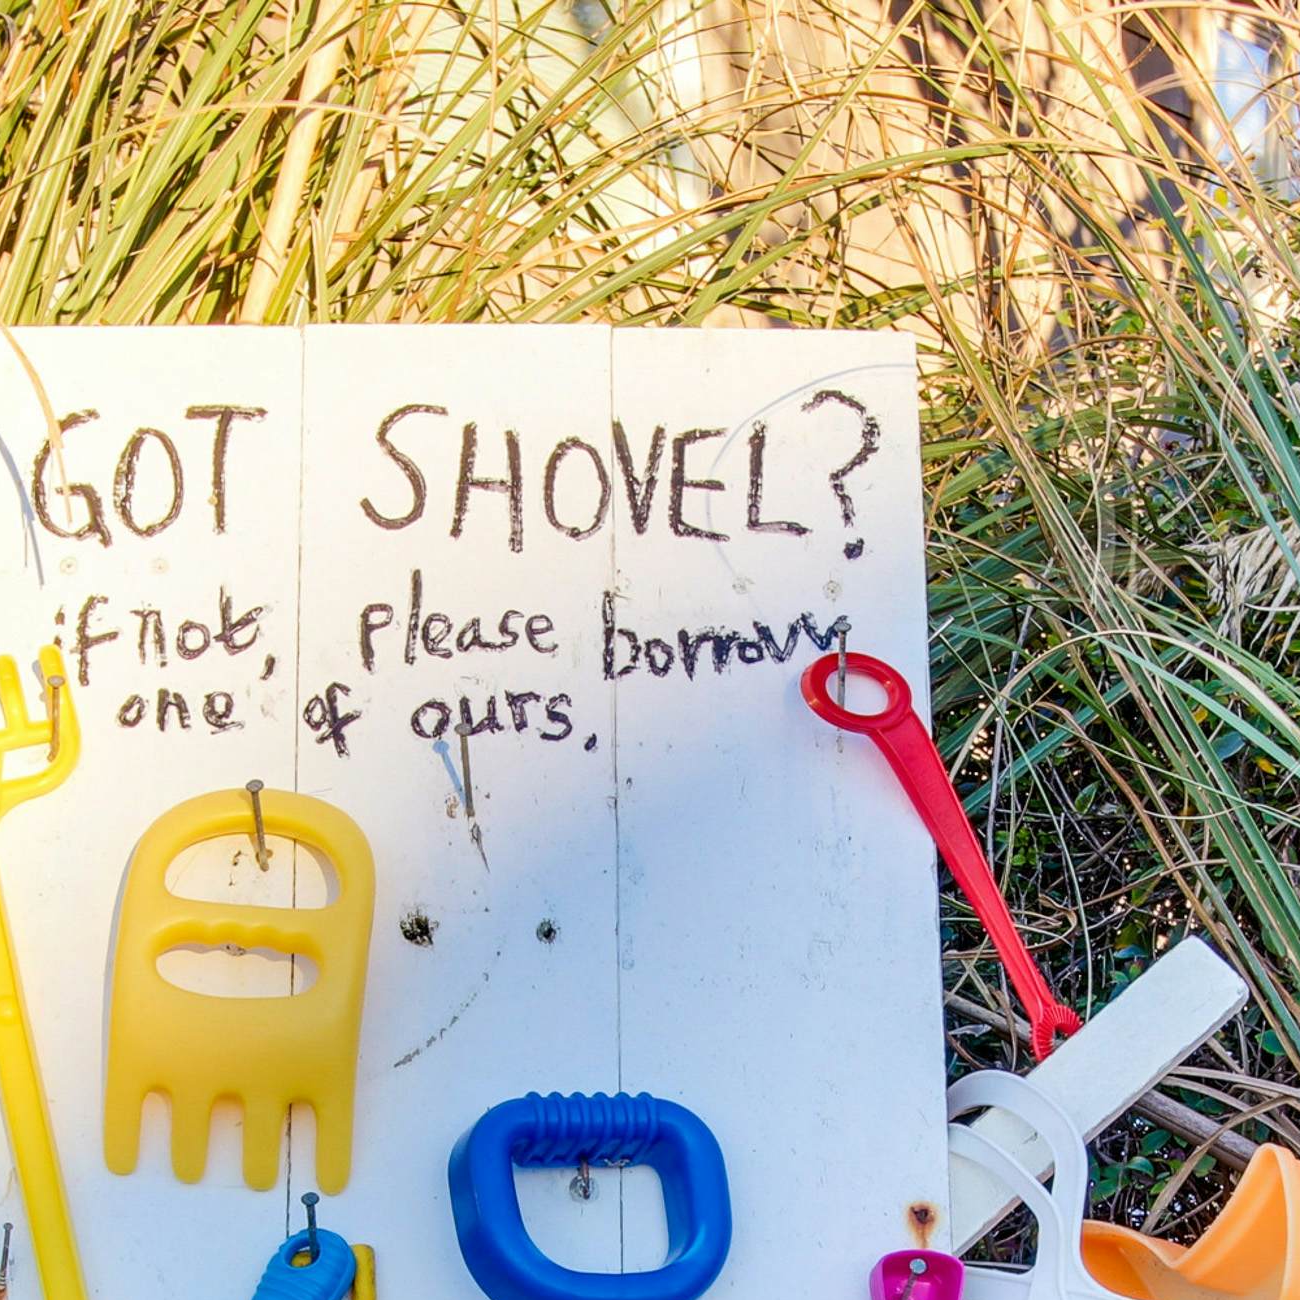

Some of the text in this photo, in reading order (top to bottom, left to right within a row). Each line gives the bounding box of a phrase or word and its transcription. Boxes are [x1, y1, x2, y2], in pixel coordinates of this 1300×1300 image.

[32, 390, 881, 560] GOT SHOVEL?
[602, 591, 847, 681] borrow
[117, 688, 245, 735] one
[303, 682, 361, 758] of
